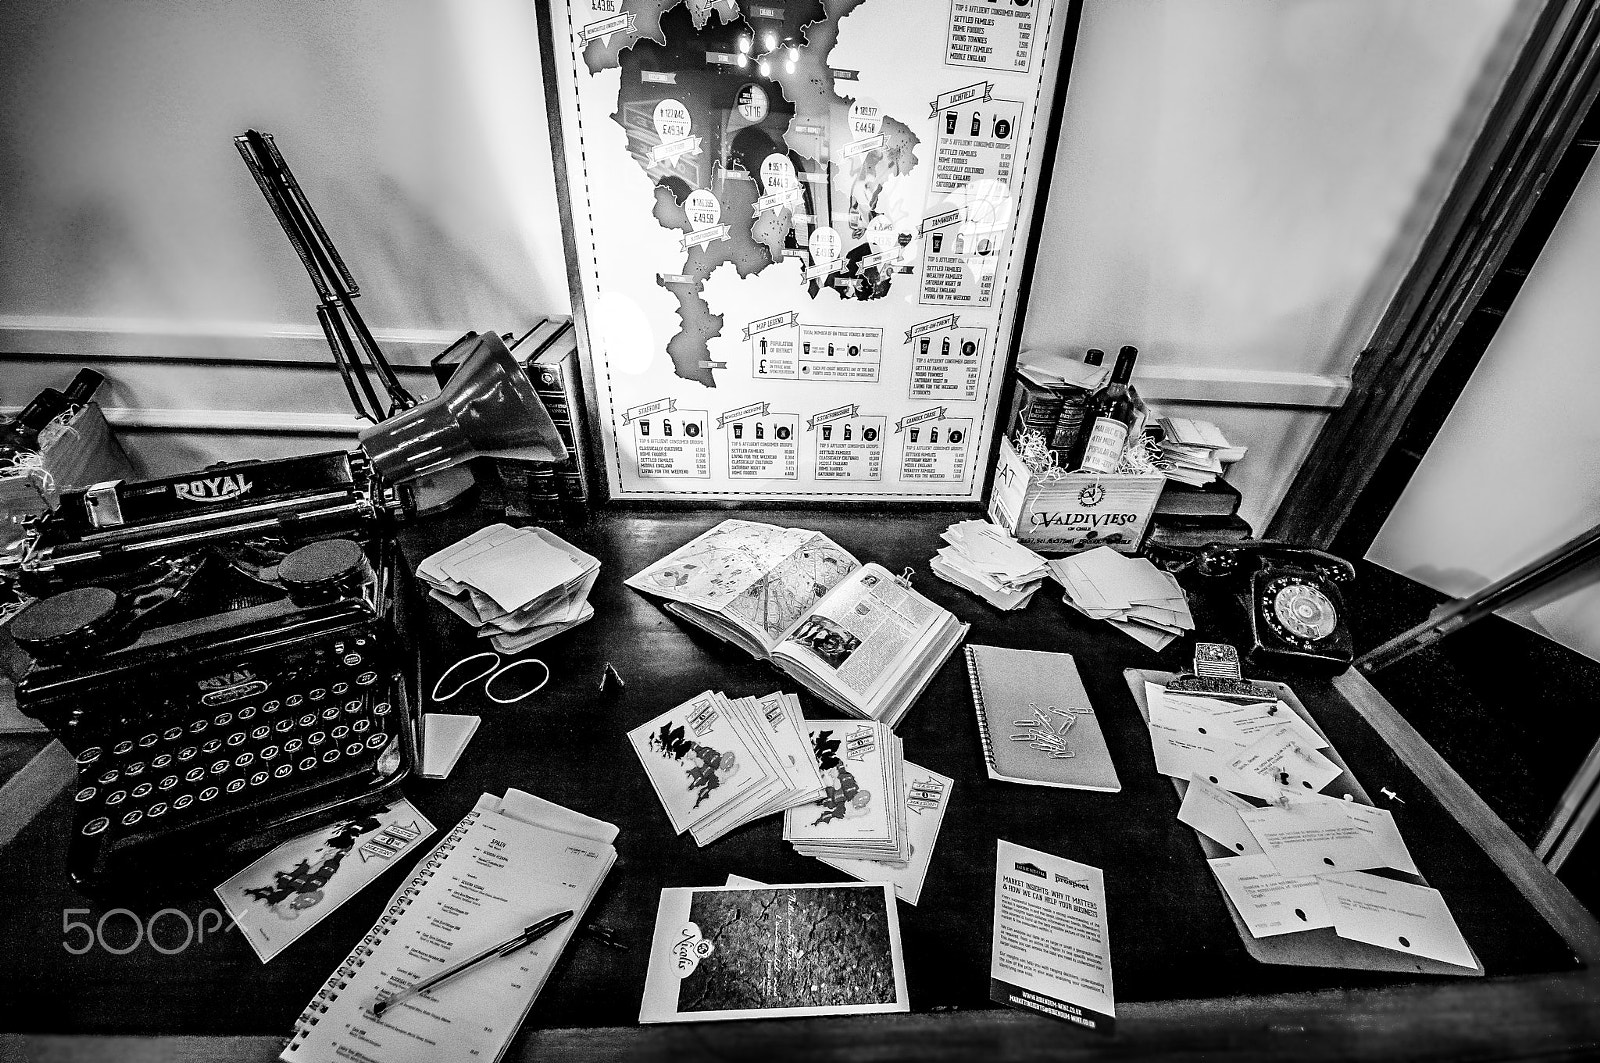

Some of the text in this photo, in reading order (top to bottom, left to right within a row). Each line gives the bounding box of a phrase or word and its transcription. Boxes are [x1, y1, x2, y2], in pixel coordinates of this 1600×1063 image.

[954, 16, 994, 26] SETTLED FAMILIES
[174, 474, 252, 502] ROYAL
[1031, 512, 1137, 528] VALDIVIESO
[1003, 875, 1025, 887] MARKET
[1051, 890, 1064, 900] WHY
[1072, 896, 1097, 910] MATTERS
[1055, 876, 1089, 890] prospect
[1009, 884, 1021, 894] HOW
[1023, 889, 1031, 897] WE
[1045, 896, 1057, 905] HELP
[1059, 900, 1072, 910] YOUR
[1074, 905, 1097, 918] BUSINESS
